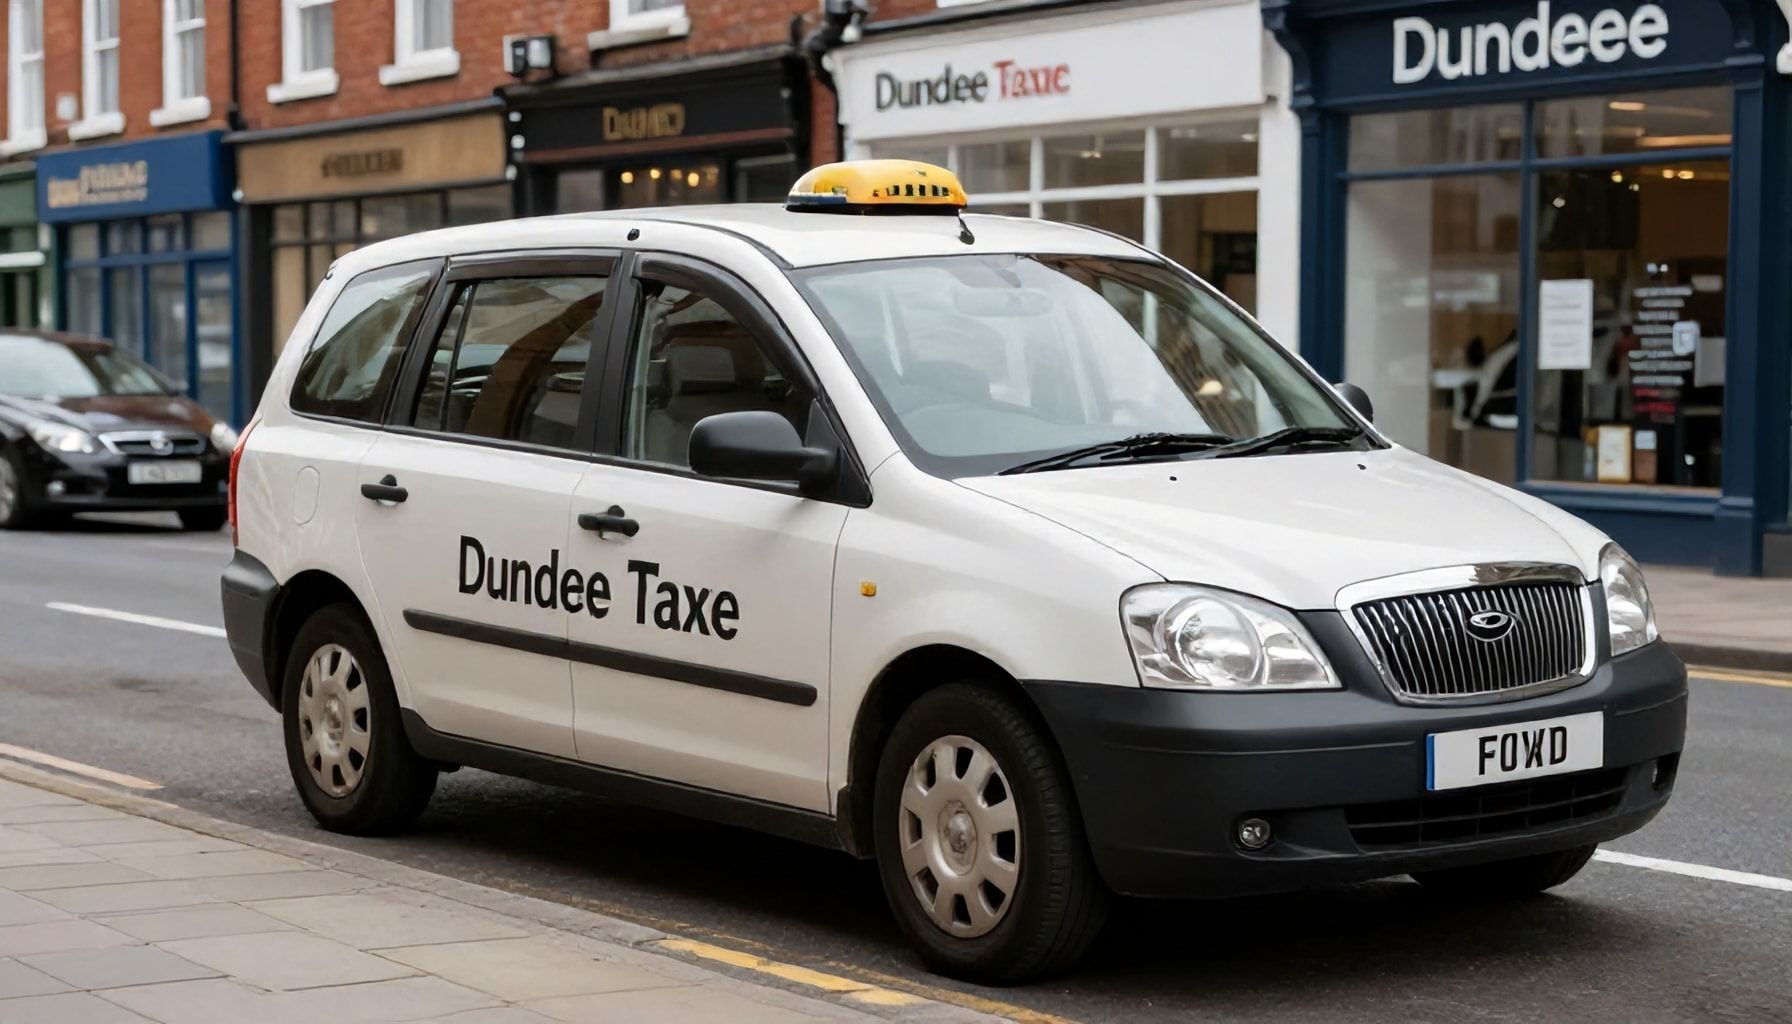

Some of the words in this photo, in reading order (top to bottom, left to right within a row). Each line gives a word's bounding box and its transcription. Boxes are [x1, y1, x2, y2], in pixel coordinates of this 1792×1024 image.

[1392, 0, 1669, 84] Dundeee
[875, 63, 989, 112] Dundee
[458, 534, 612, 619] Dundee
[627, 559, 740, 641] Taxe
